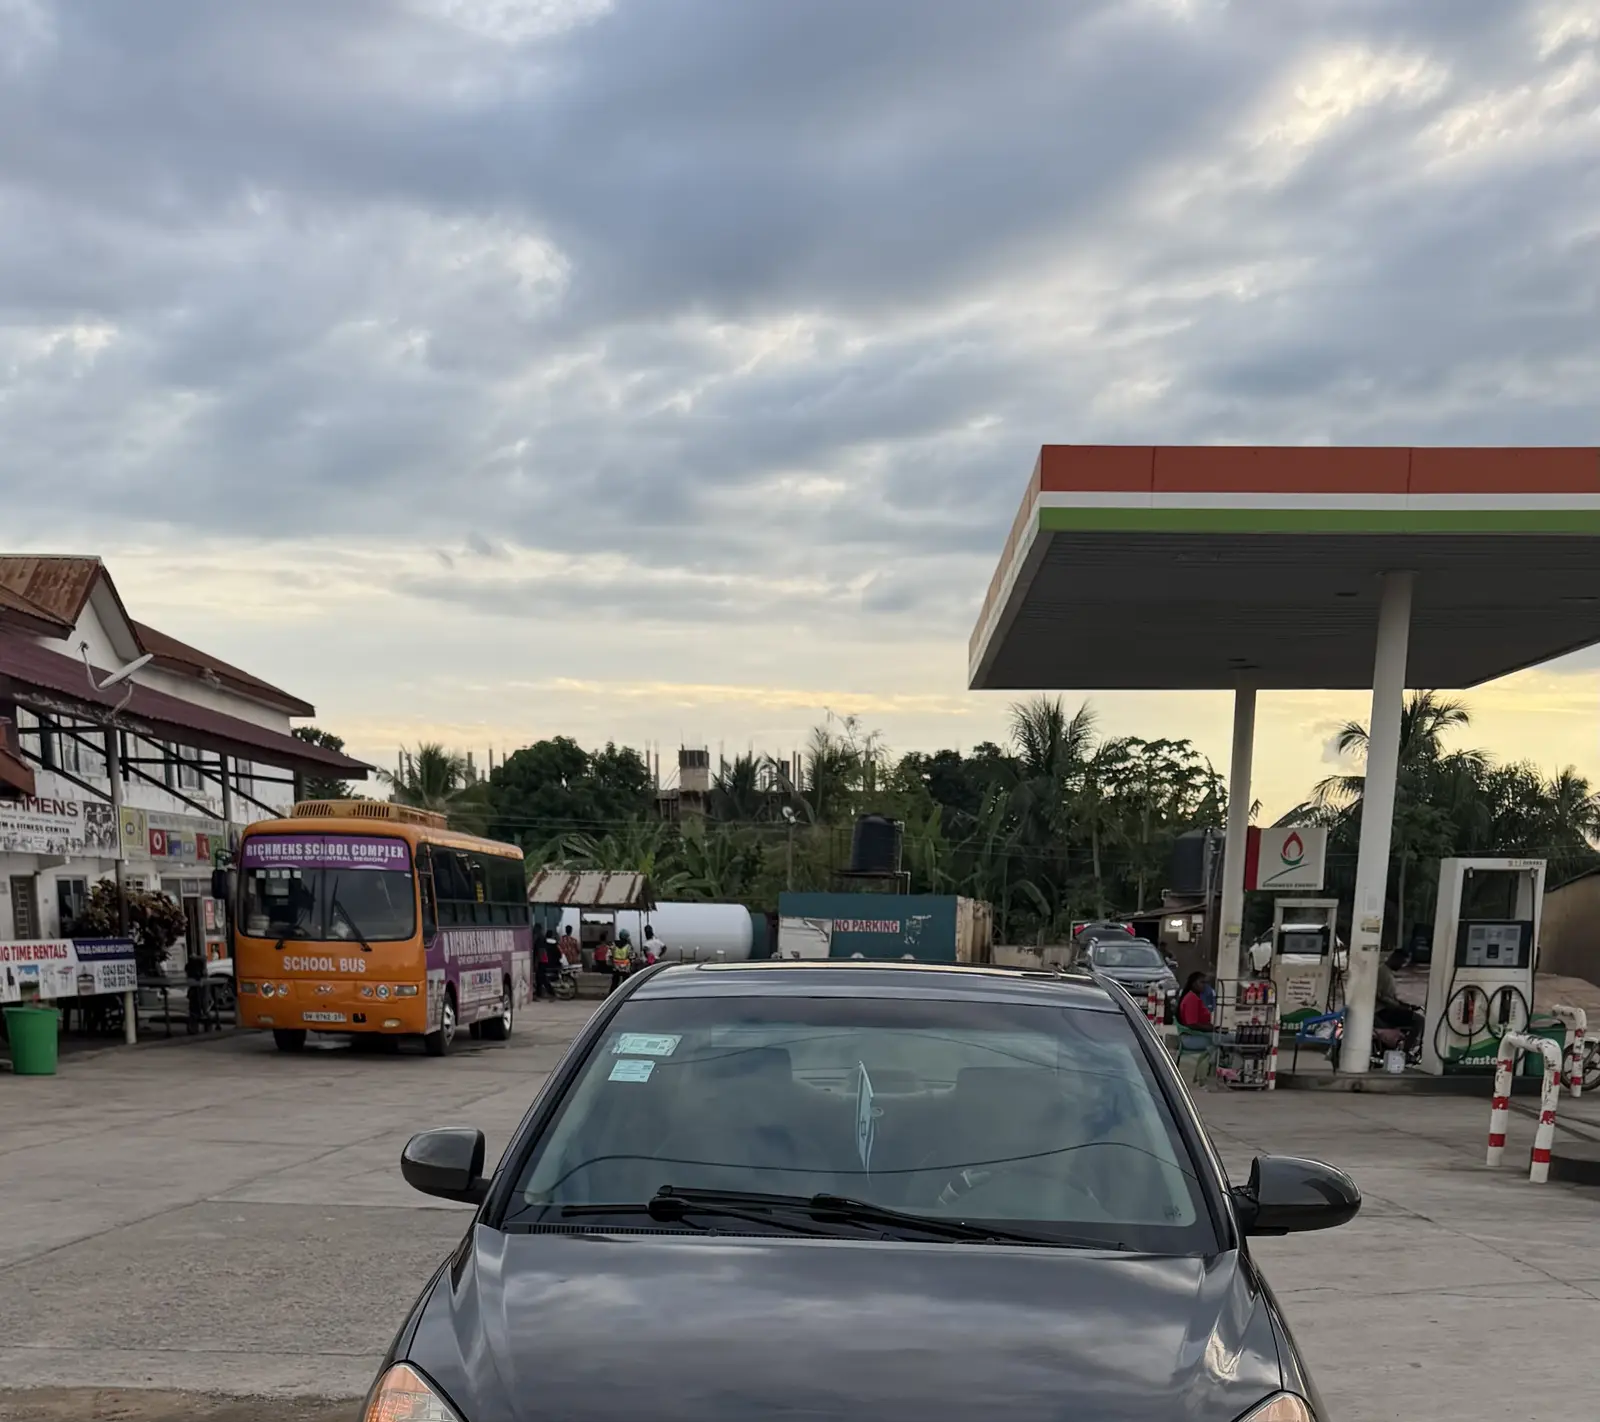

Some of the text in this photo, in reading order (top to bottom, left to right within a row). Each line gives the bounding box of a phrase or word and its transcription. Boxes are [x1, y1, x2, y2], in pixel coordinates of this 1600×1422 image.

[246, 843, 404, 859] RICHMENS SCHOOL COMPLEX
[835, 920, 850, 931] NO
[852, 920, 899, 932] PARKING
[11, 946, 32, 961] TIME
[33, 944, 67, 960] RENTALS
[283, 956, 366, 973] SCHOOL BUS
